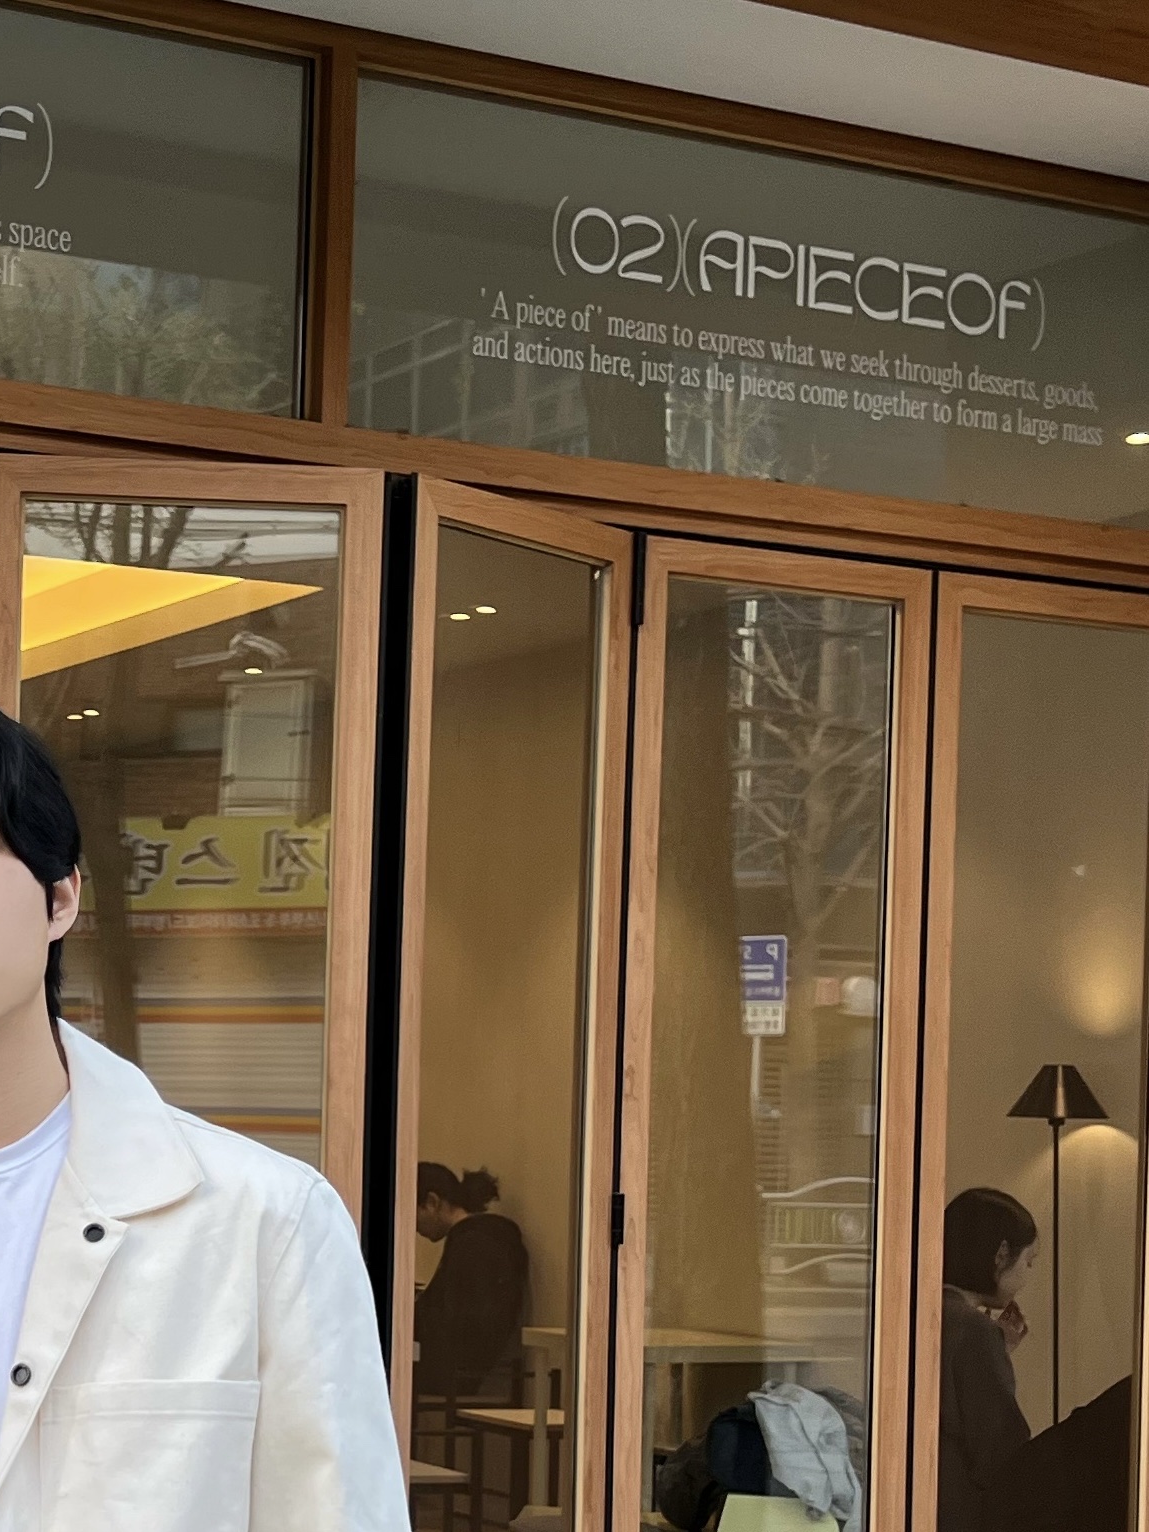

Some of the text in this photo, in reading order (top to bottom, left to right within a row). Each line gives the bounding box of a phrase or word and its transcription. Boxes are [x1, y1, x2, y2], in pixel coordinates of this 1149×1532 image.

[8, 222, 72, 253] space
[473, 331, 1103, 447] and actions here, just as the pieces come together to form a large mass
[516, 294, 566, 329] piece
[607, 313, 667, 345] means
[672, 323, 693, 348] to
[698, 329, 765, 360] express
[770, 335, 814, 367] what
[820, 348, 845, 371] we
[851, 350, 889, 378] seek
[895, 355, 963, 394] through
[968, 365, 1040, 402] desserts,
